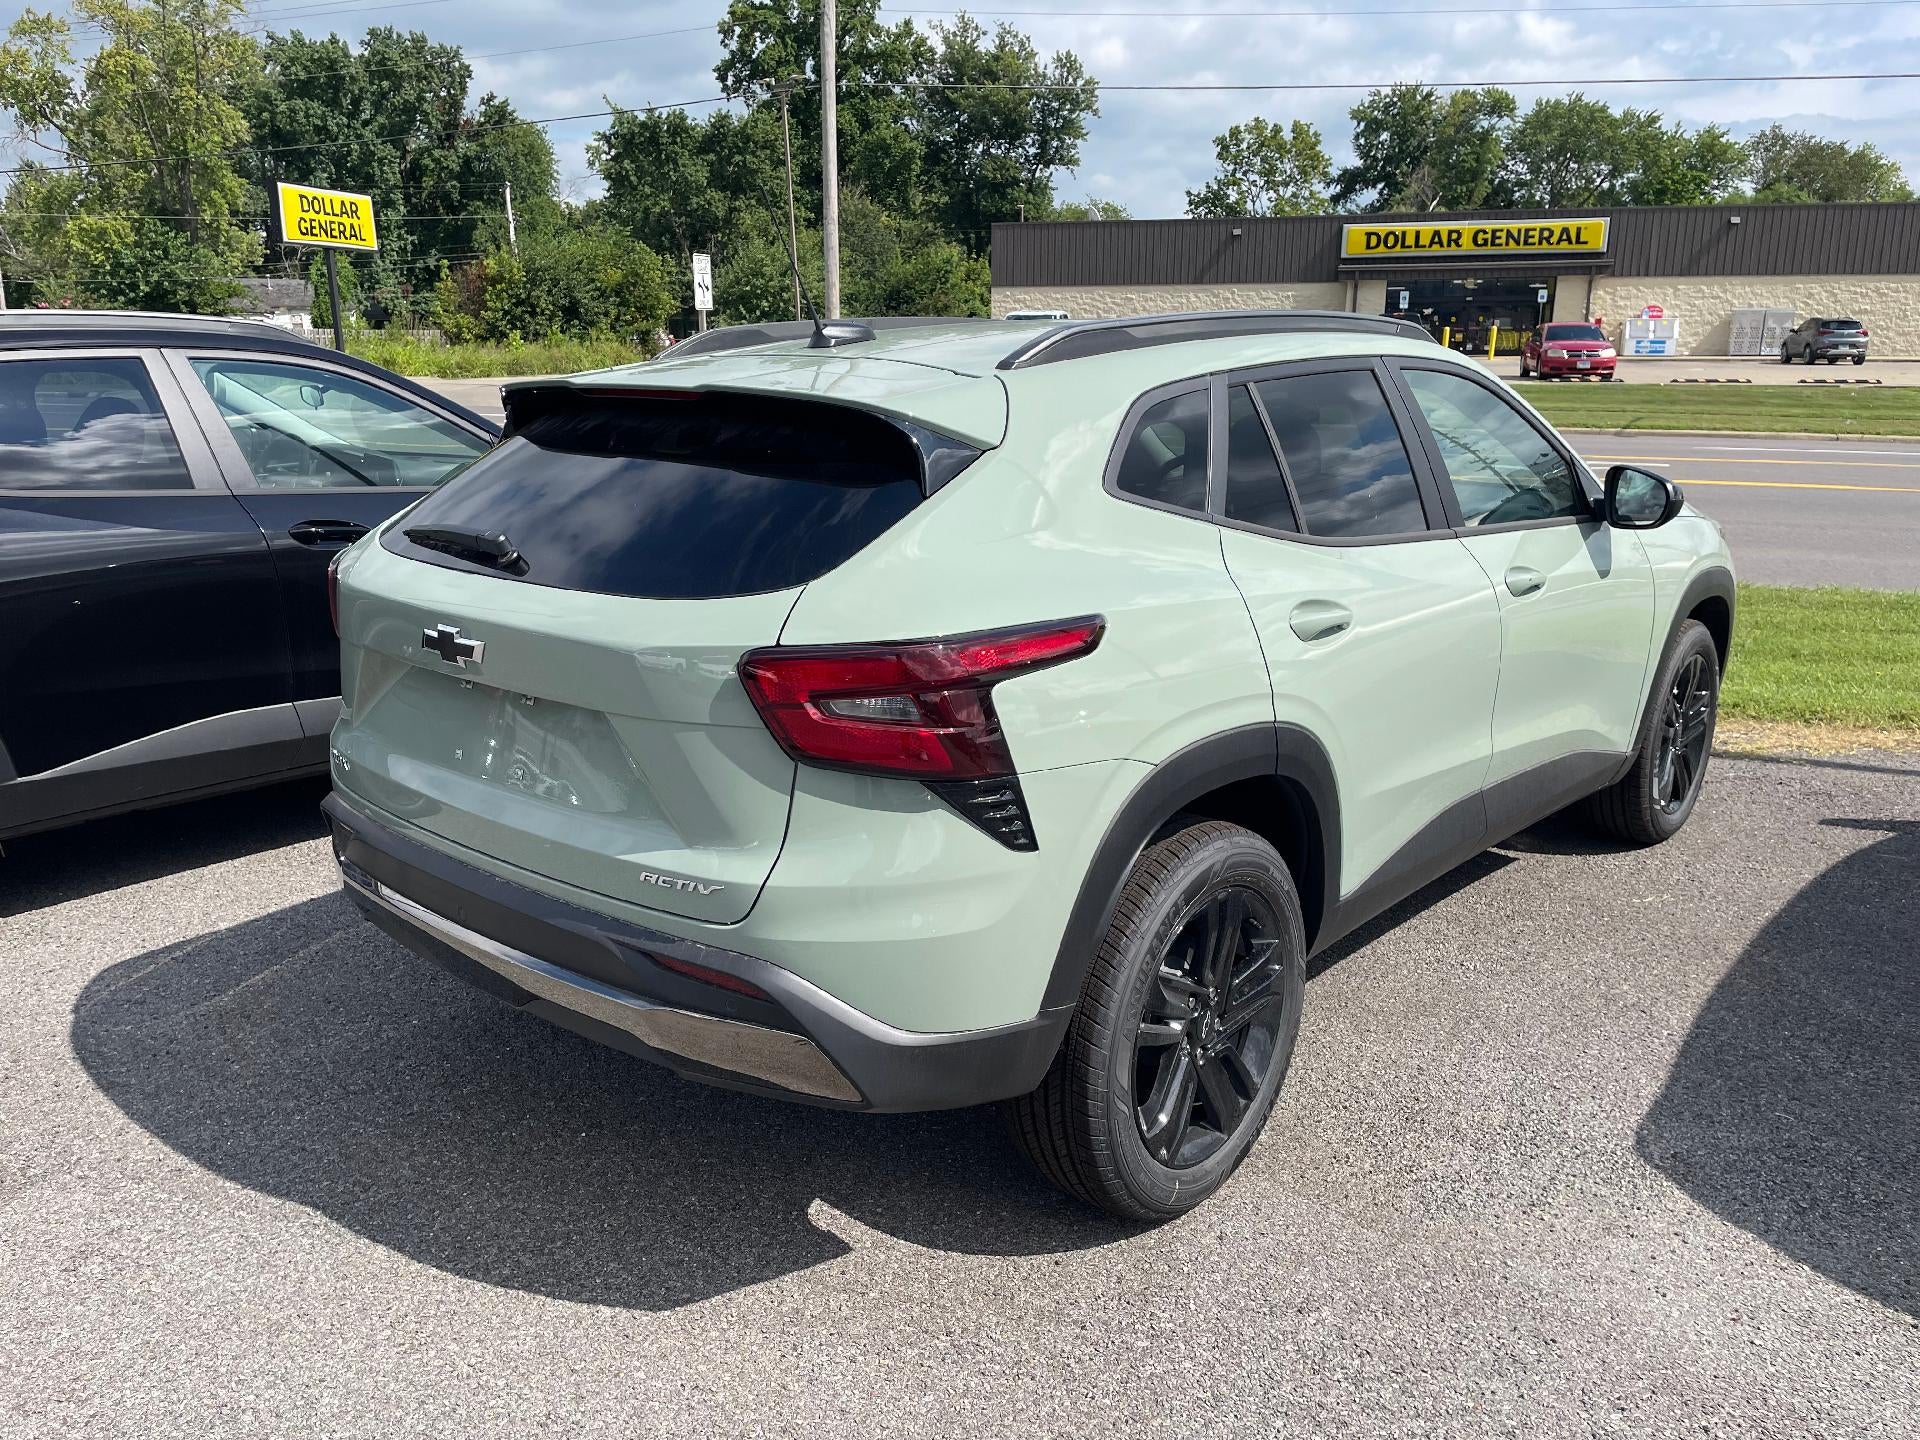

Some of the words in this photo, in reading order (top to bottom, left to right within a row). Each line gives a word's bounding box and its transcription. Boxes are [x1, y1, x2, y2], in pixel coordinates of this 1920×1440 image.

[298, 194, 361, 220] DOLLAR
[297, 216, 367, 242] GENERAL
[1364, 228, 1463, 250] DOLLAR
[1471, 226, 1589, 248] GENERAL
[639, 871, 725, 895] ACTIV
